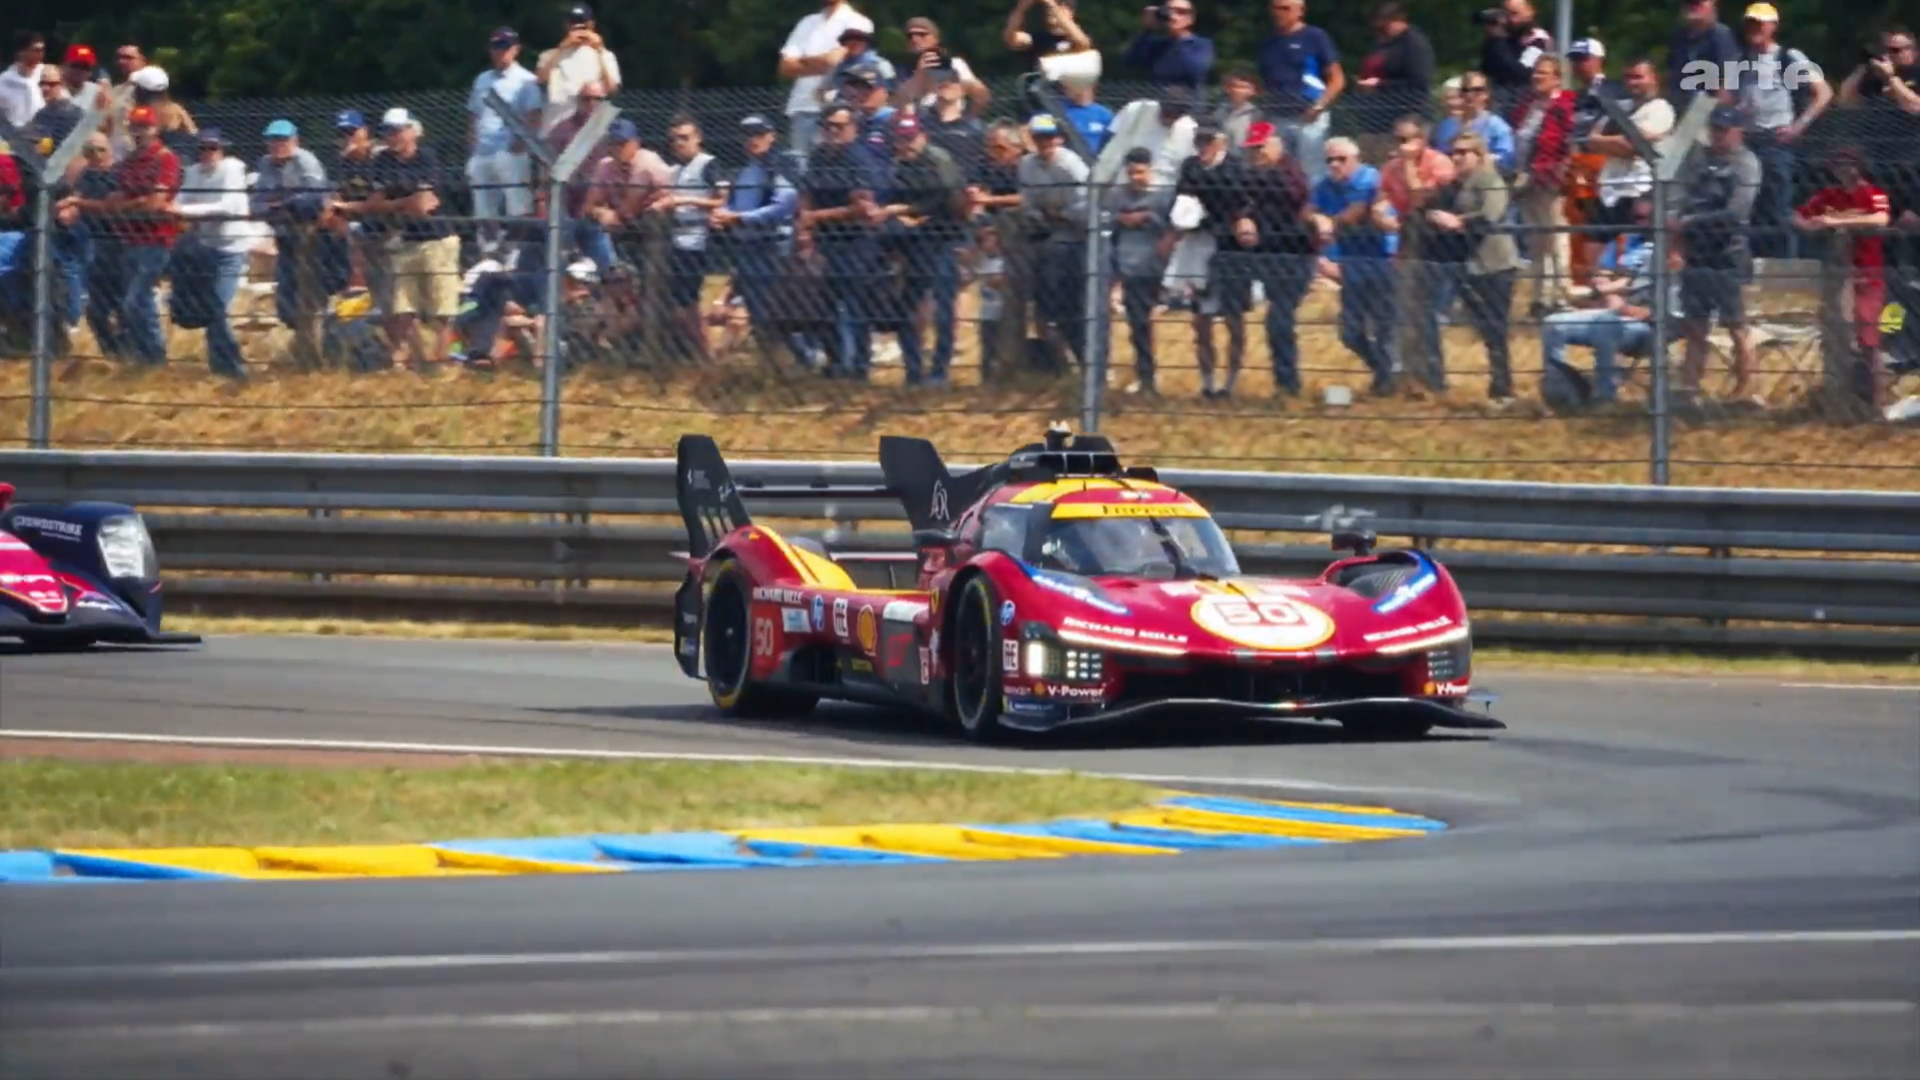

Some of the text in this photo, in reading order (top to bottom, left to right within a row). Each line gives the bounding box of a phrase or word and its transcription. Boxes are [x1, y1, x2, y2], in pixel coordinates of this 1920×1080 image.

[1214, 602, 1308, 626] 50
[755, 616, 774, 656] 50
[1063, 617, 1188, 643] RICHARD MILLE
[1047, 684, 1104, 697] V-Power
